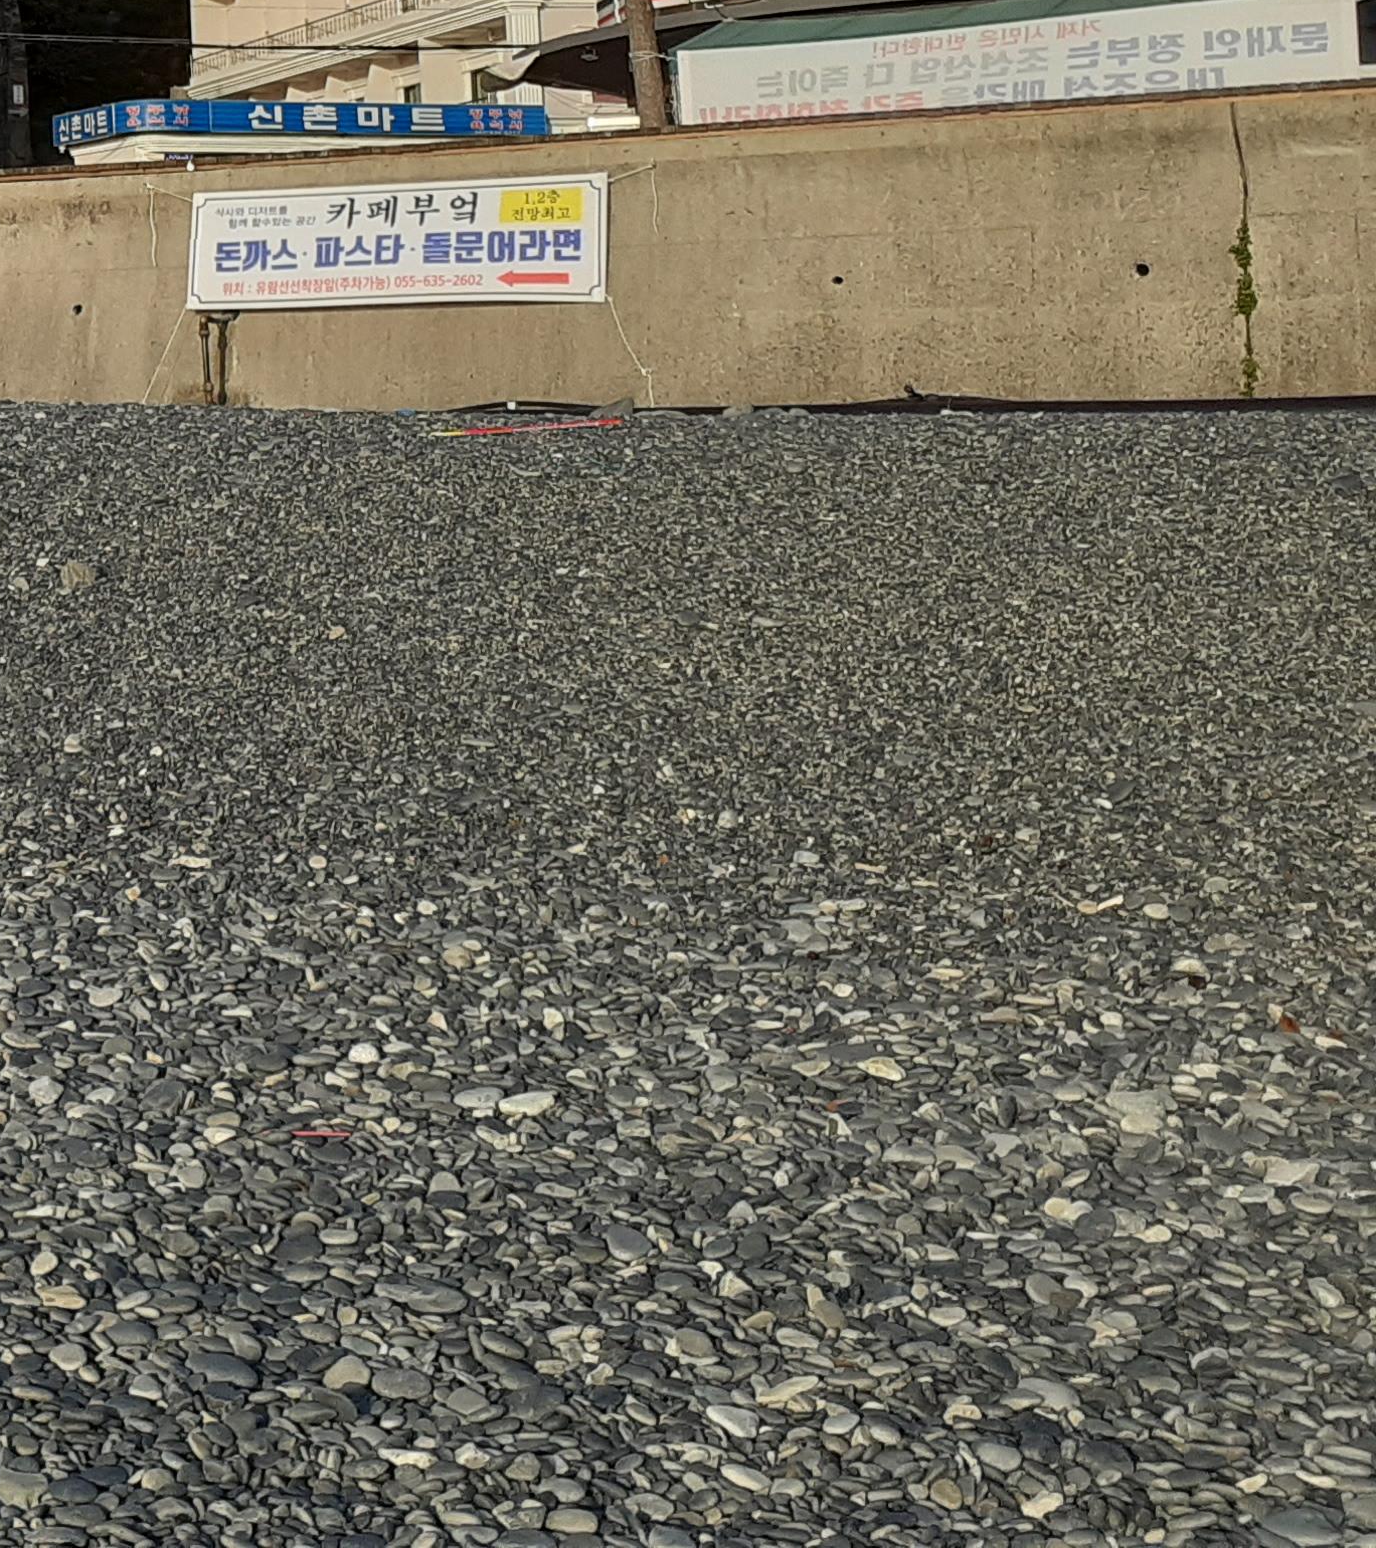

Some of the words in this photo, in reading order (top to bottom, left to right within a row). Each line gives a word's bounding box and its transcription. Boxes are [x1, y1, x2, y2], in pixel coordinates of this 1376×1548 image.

[59, 110, 108, 142] 신촌마트
[248, 105, 446, 132] 신촌마트
[524, 189, 560, 205] 1,2층
[295, 216, 316, 226] 공간
[512, 206, 570, 221] 전망최고
[214, 240, 298, 272] 돈까스
[315, 234, 404, 268] 파스타
[421, 228, 582, 263] 돌문어라면
[222, 282, 244, 296] 위치
[394, 274, 484, 289] 055-635-2602
